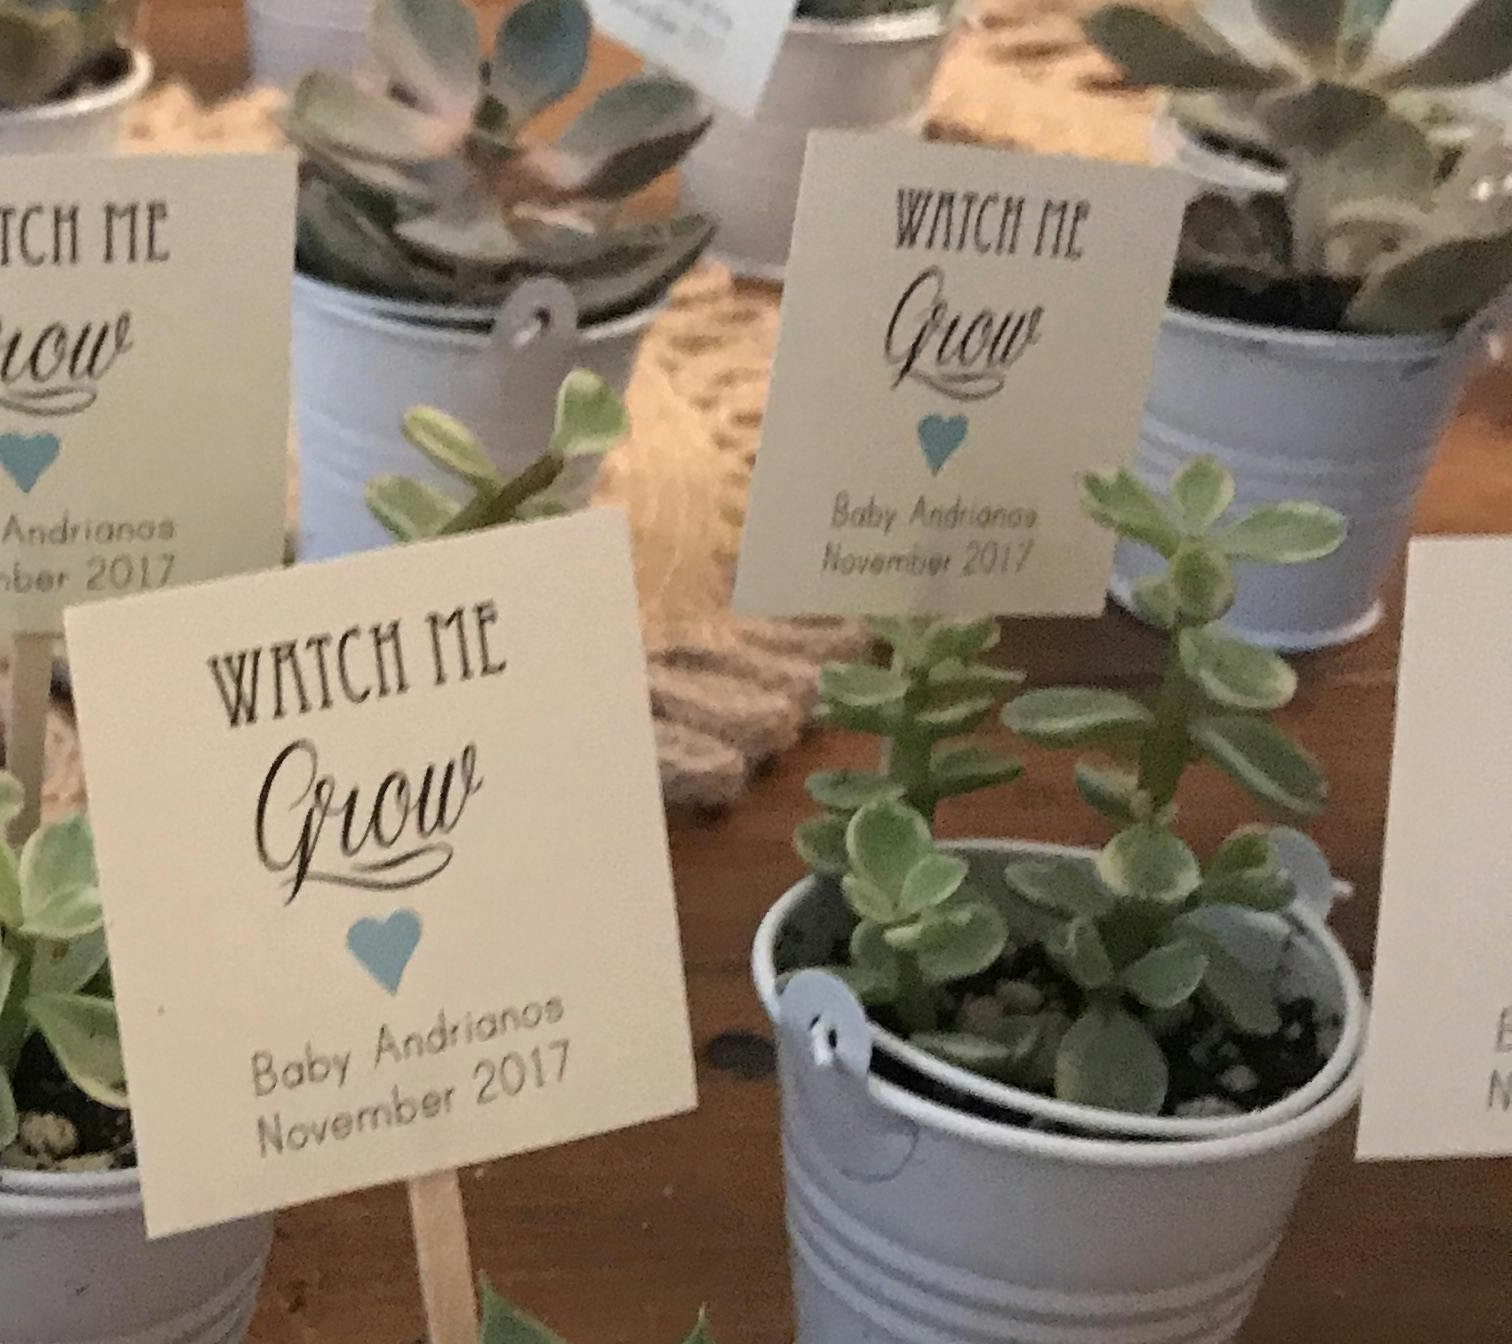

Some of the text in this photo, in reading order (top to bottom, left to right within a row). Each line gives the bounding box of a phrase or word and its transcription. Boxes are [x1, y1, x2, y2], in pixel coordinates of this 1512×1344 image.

[103, 199, 171, 265] ME
[895, 186, 1091, 260] WATCH ME
[884, 264, 1045, 403] Grow
[1, 512, 178, 548] Andrianos
[829, 490, 1039, 534] Baby Andrianos
[86, 554, 176, 592] 2017
[822, 539, 1036, 577] November 2017
[206, 598, 508, 730] WATCH ME
[254, 736, 485, 908] Grow
[249, 994, 566, 1099] Baby Andrianos
[255, 1038, 572, 1158] November 2017
